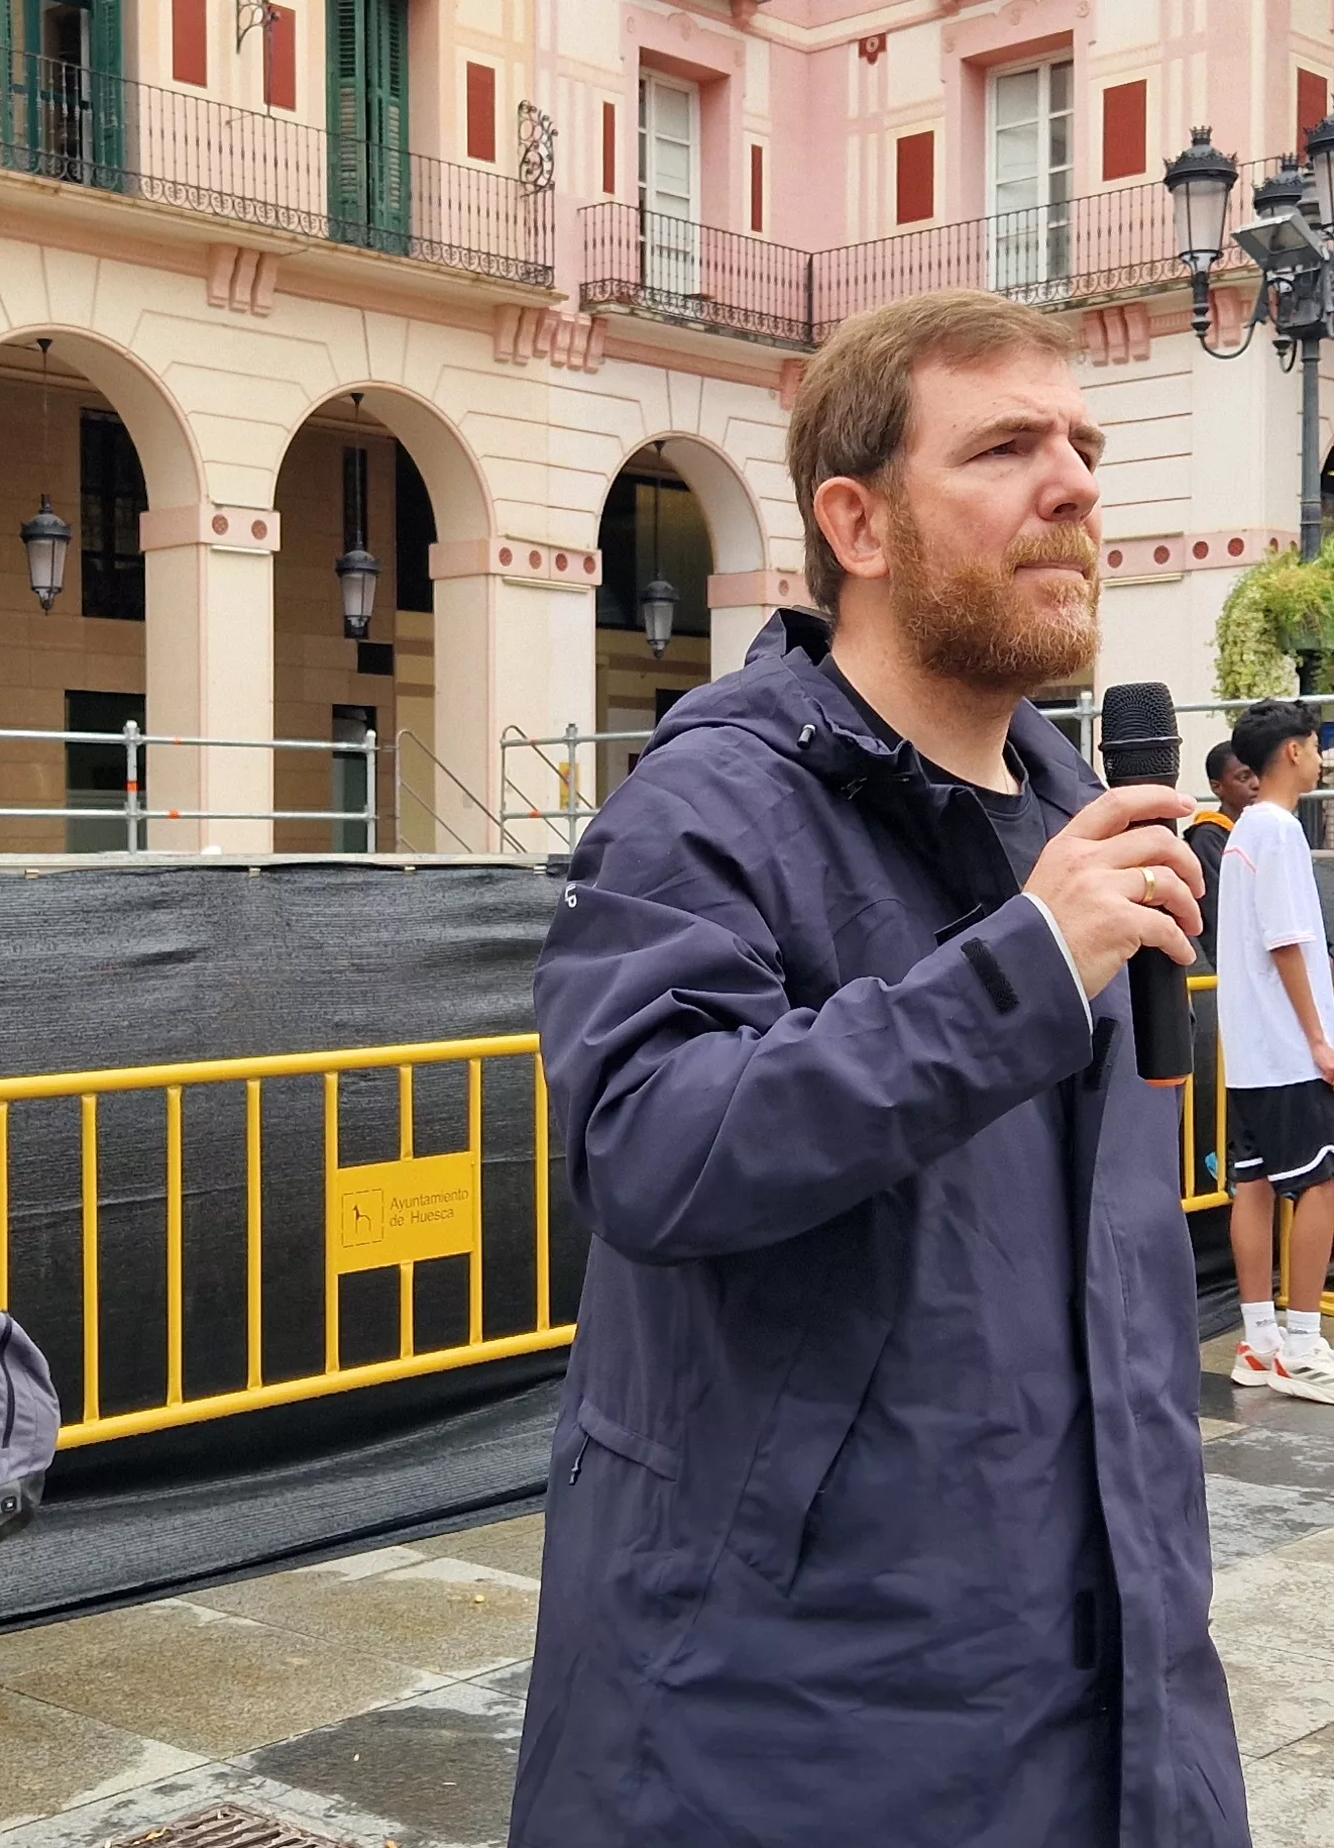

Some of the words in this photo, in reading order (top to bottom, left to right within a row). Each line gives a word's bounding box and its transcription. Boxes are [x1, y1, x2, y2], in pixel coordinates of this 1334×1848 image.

[390, 1188, 468, 1213] Ayuntamiento
[389, 1213, 405, 1228] de
[410, 1207, 455, 1225] Huesca
